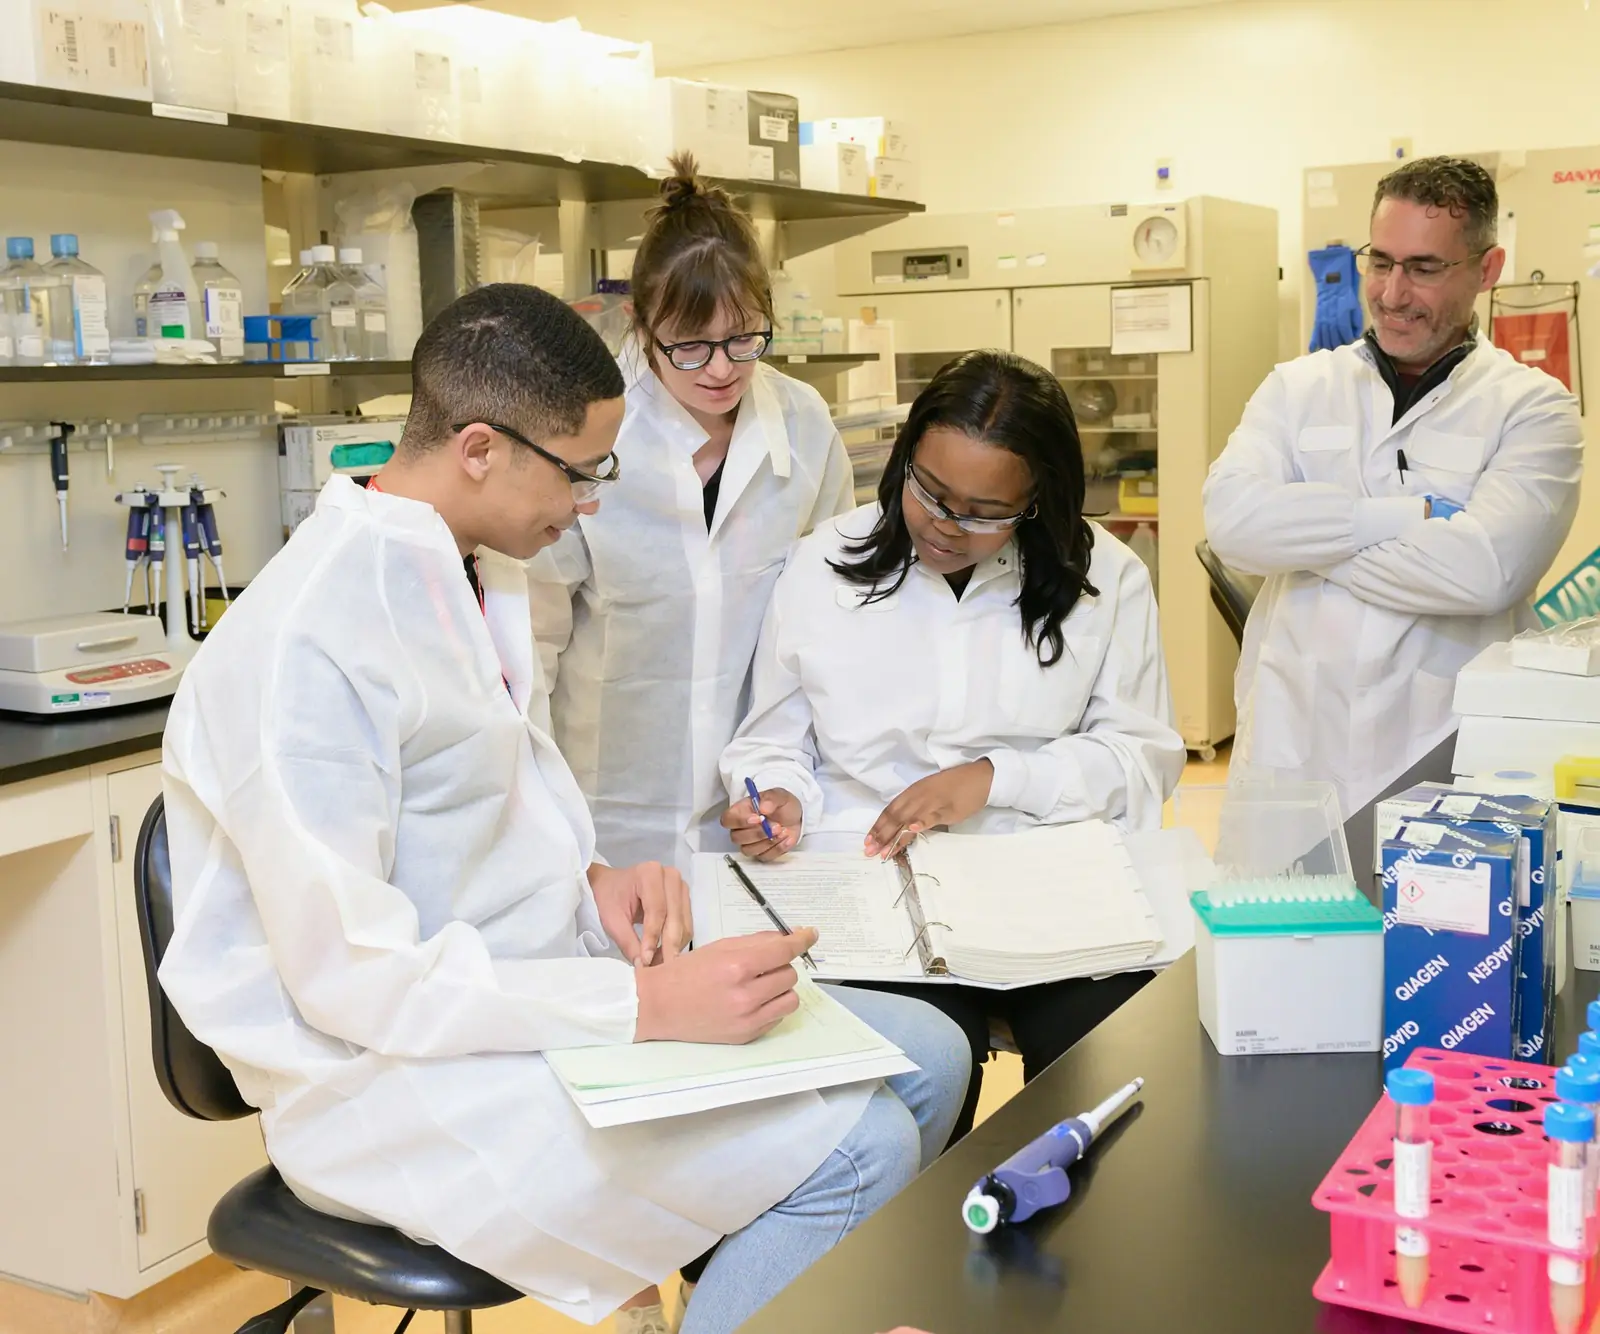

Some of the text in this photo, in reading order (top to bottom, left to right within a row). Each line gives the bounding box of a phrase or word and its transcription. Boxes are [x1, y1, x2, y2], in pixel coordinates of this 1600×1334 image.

[1395, 954, 1449, 1001] QIAGEN
[1468, 936, 1512, 984] IAGEN
[1440, 1002, 1496, 1049] QIAGEN
